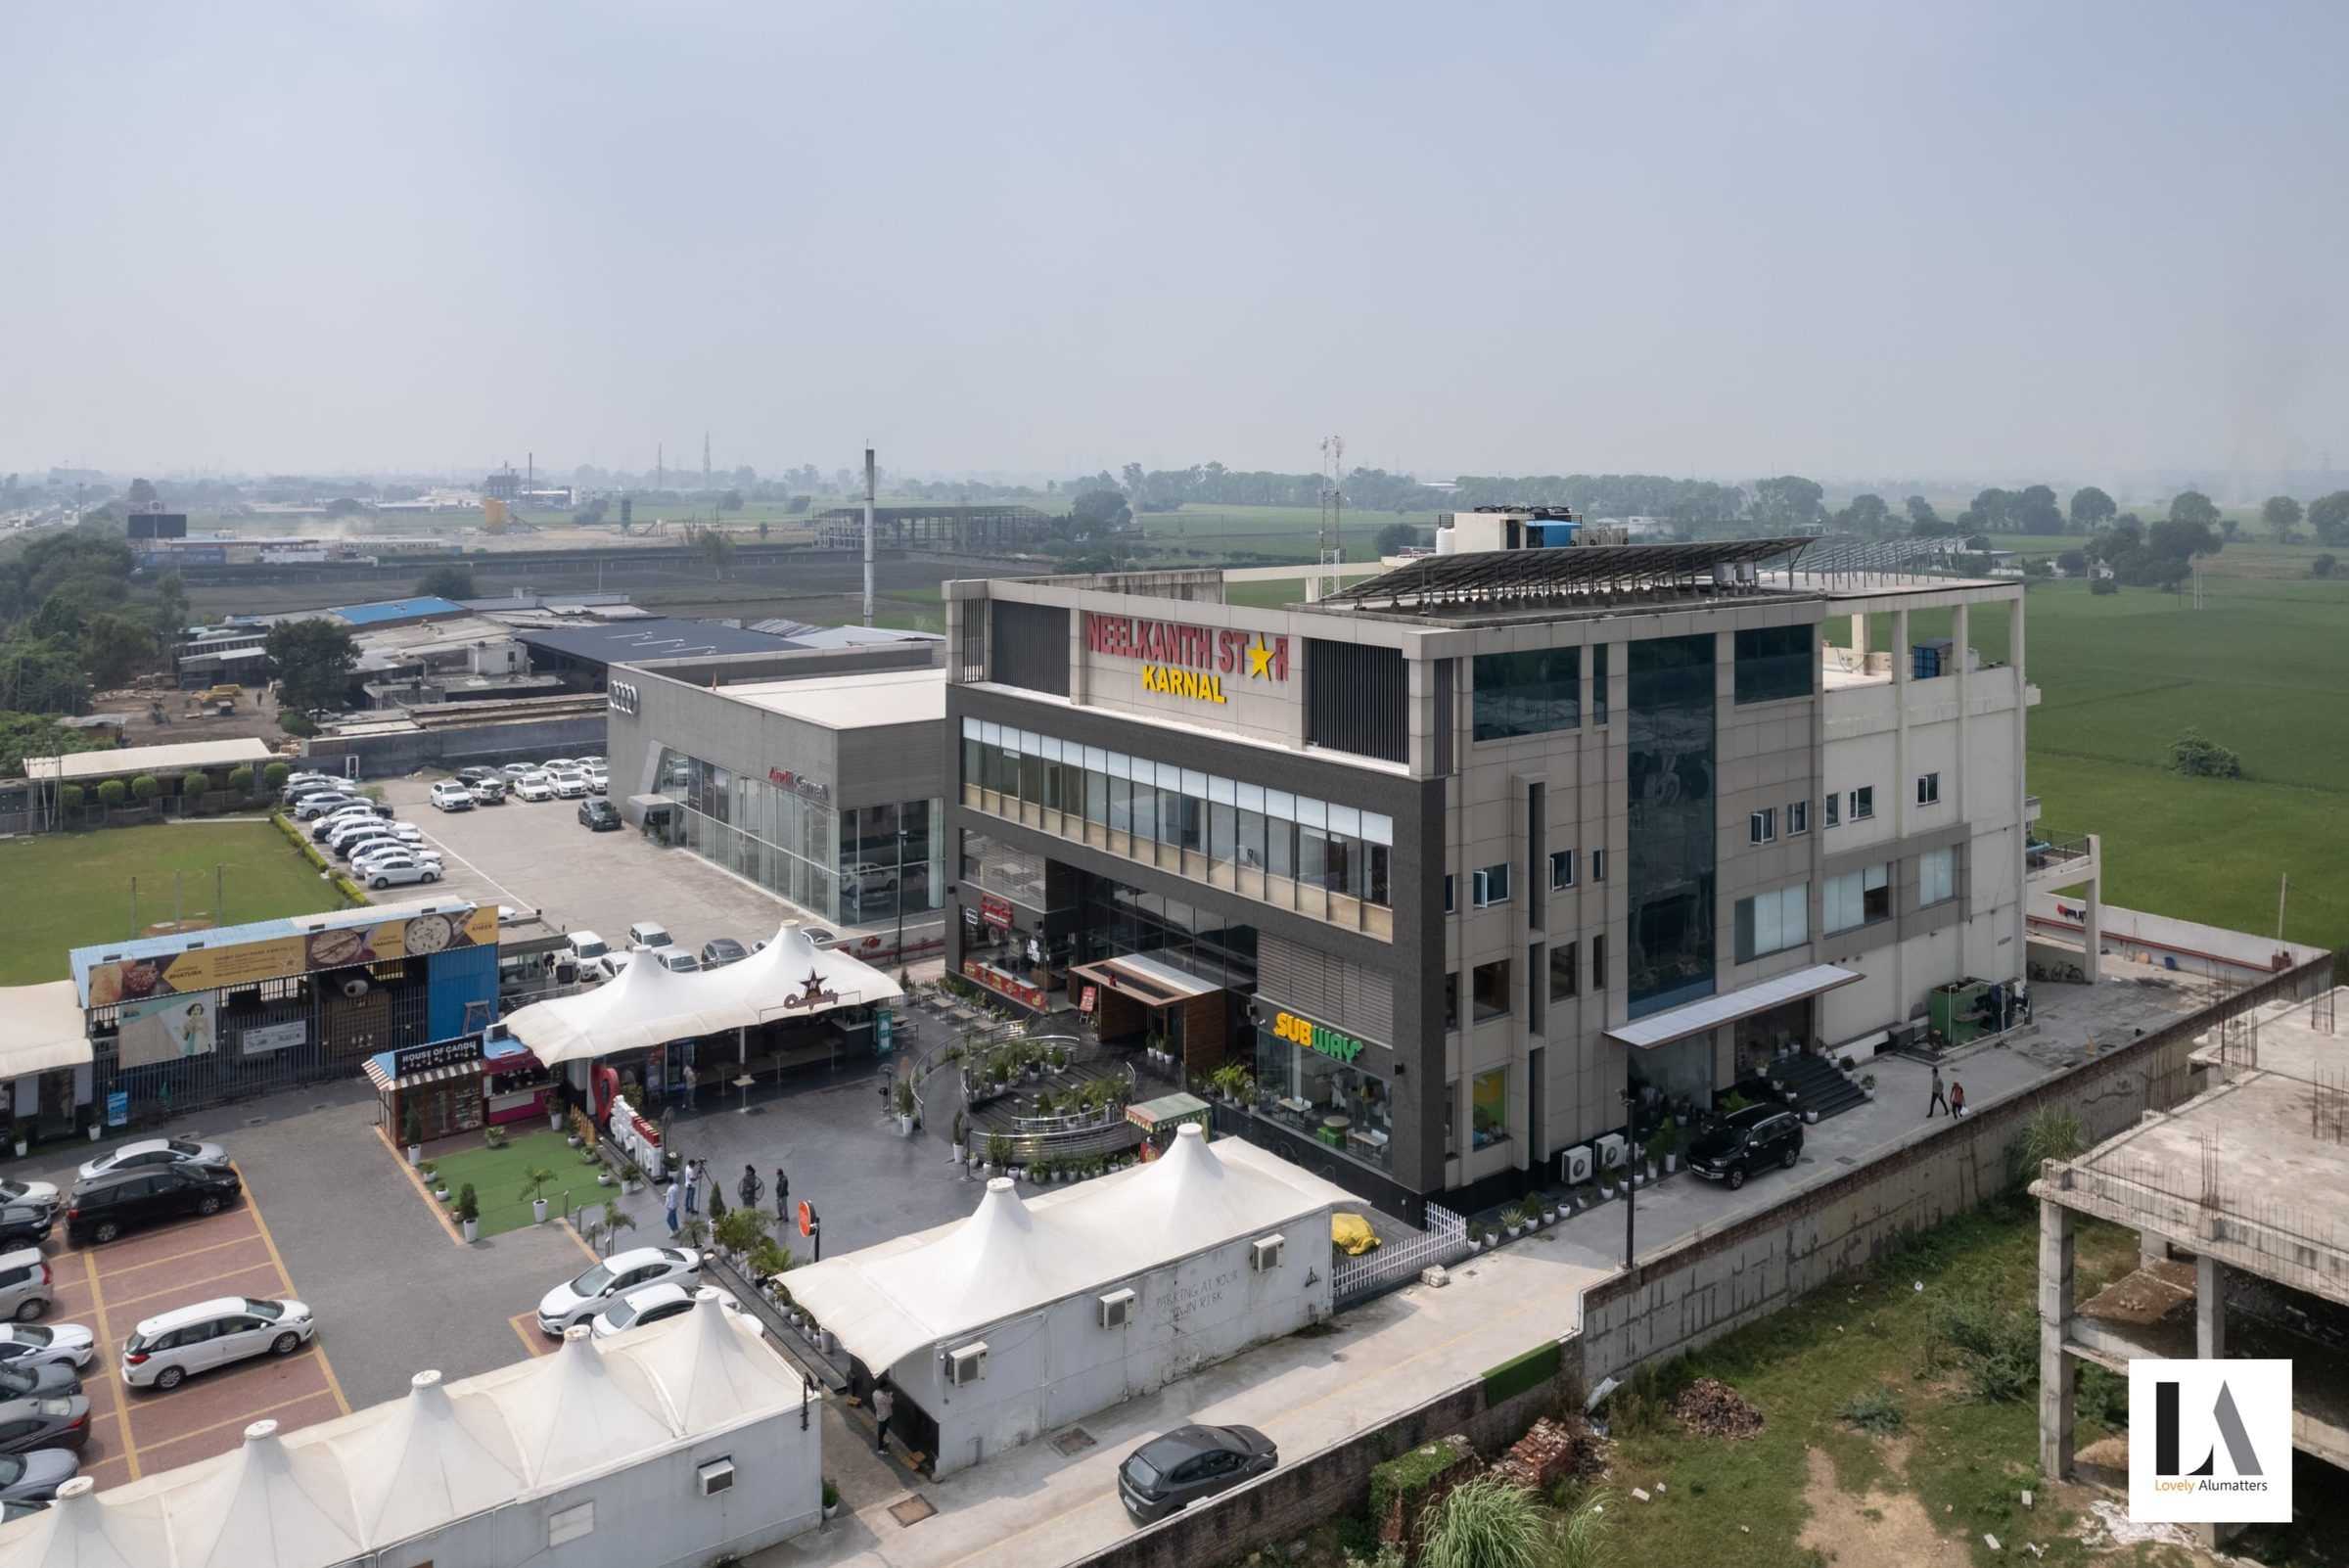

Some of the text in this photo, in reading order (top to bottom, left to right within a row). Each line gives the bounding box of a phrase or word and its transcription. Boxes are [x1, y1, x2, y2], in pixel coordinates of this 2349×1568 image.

[1087, 614, 1213, 669] NEELKANTH
[1143, 665, 1226, 704] KARNAL
[768, 766, 829, 801] Audi Karnal
[402, 1050, 432, 1064] HOUSE
[433, 1046, 444, 1057] OF
[1273, 1012, 1363, 1064] SUBWAY
[1156, 1268, 1239, 1309] PARKING AT YOUR
